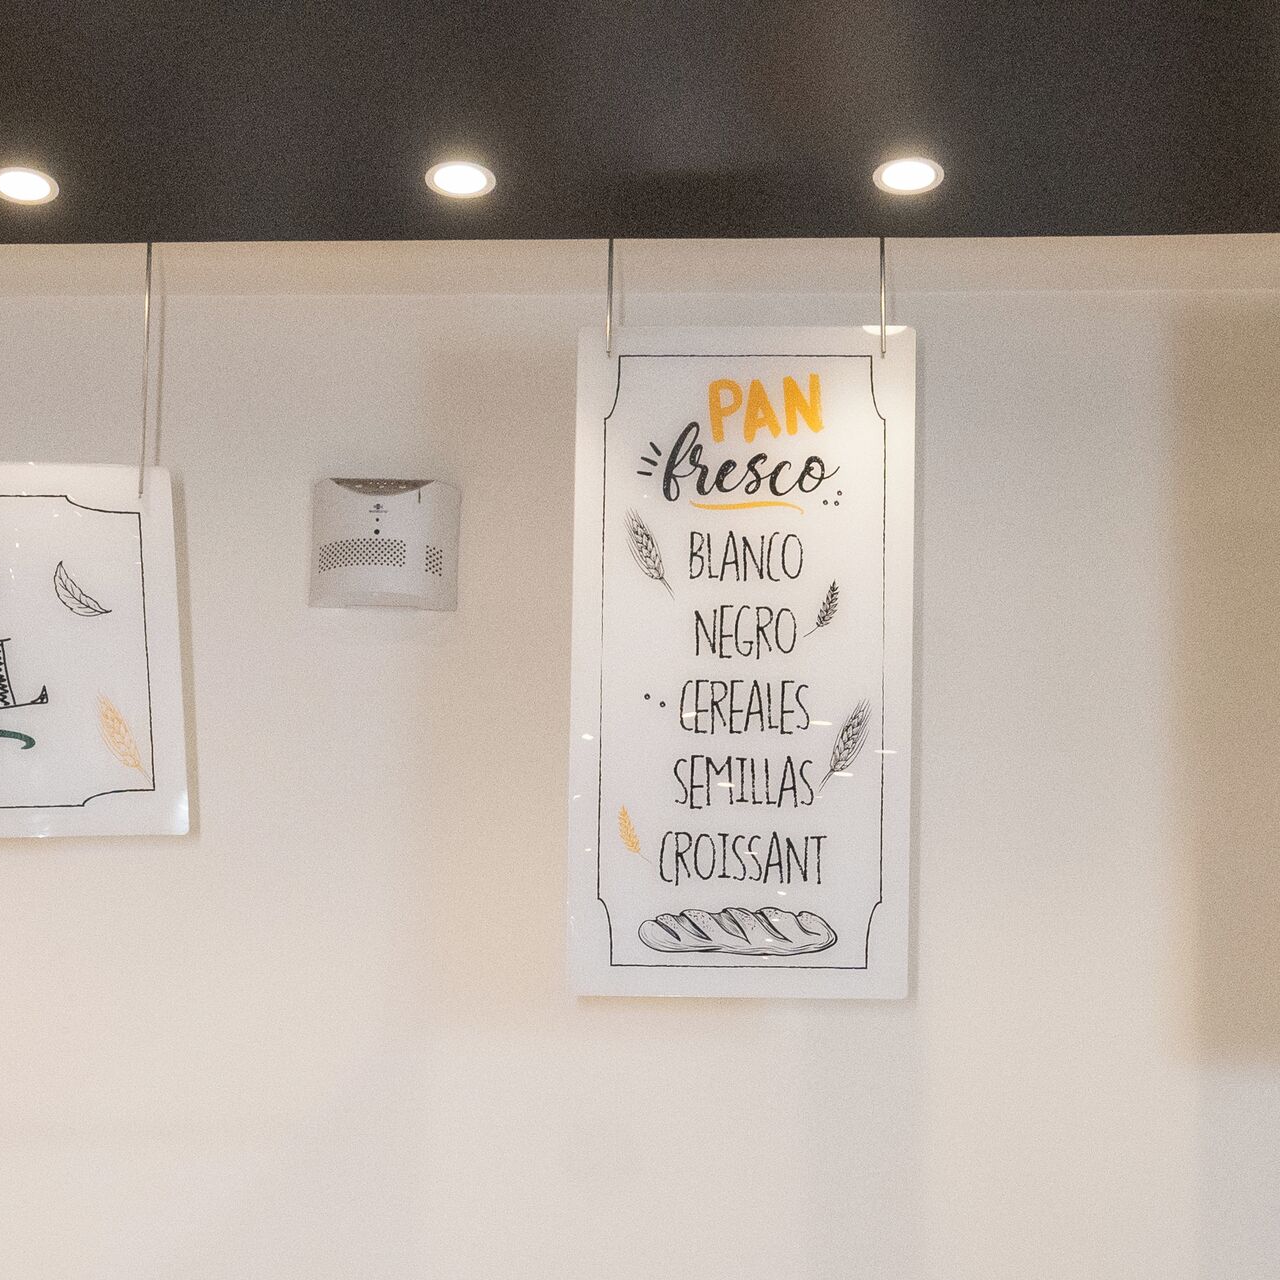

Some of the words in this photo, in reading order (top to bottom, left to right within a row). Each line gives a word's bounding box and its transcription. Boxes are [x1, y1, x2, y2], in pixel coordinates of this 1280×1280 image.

[707, 373, 824, 443] PAN
[662, 421, 840, 502] fresco
[689, 530, 804, 582] BLANCO
[695, 604, 797, 659] NEGRO
[679, 679, 810, 735] CEREALES
[674, 755, 815, 809] SEMILLAS
[659, 831, 828, 886] CROISSANT
